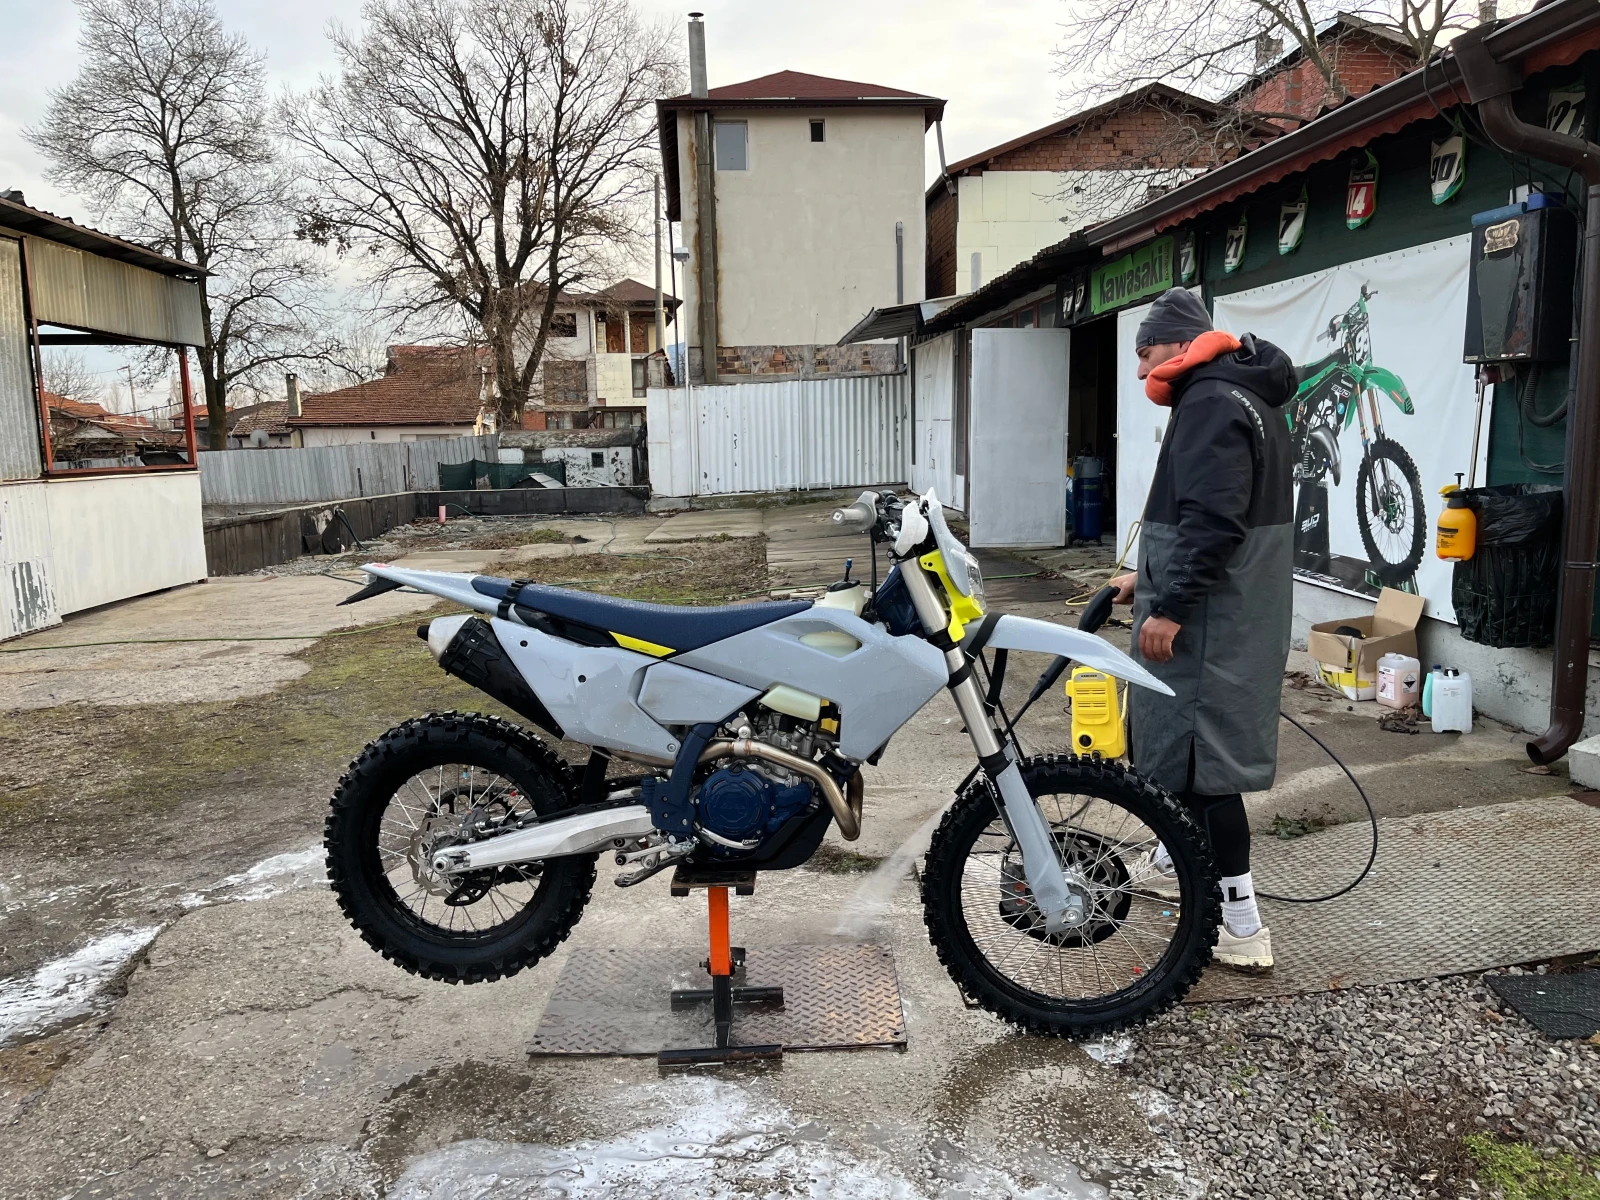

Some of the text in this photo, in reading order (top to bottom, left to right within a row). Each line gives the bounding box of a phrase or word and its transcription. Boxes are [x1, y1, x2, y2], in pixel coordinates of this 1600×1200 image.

[1280, 212, 1300, 240] 7
[1226, 234, 1243, 259] 21
[1100, 246, 1163, 305] Kawasaki
